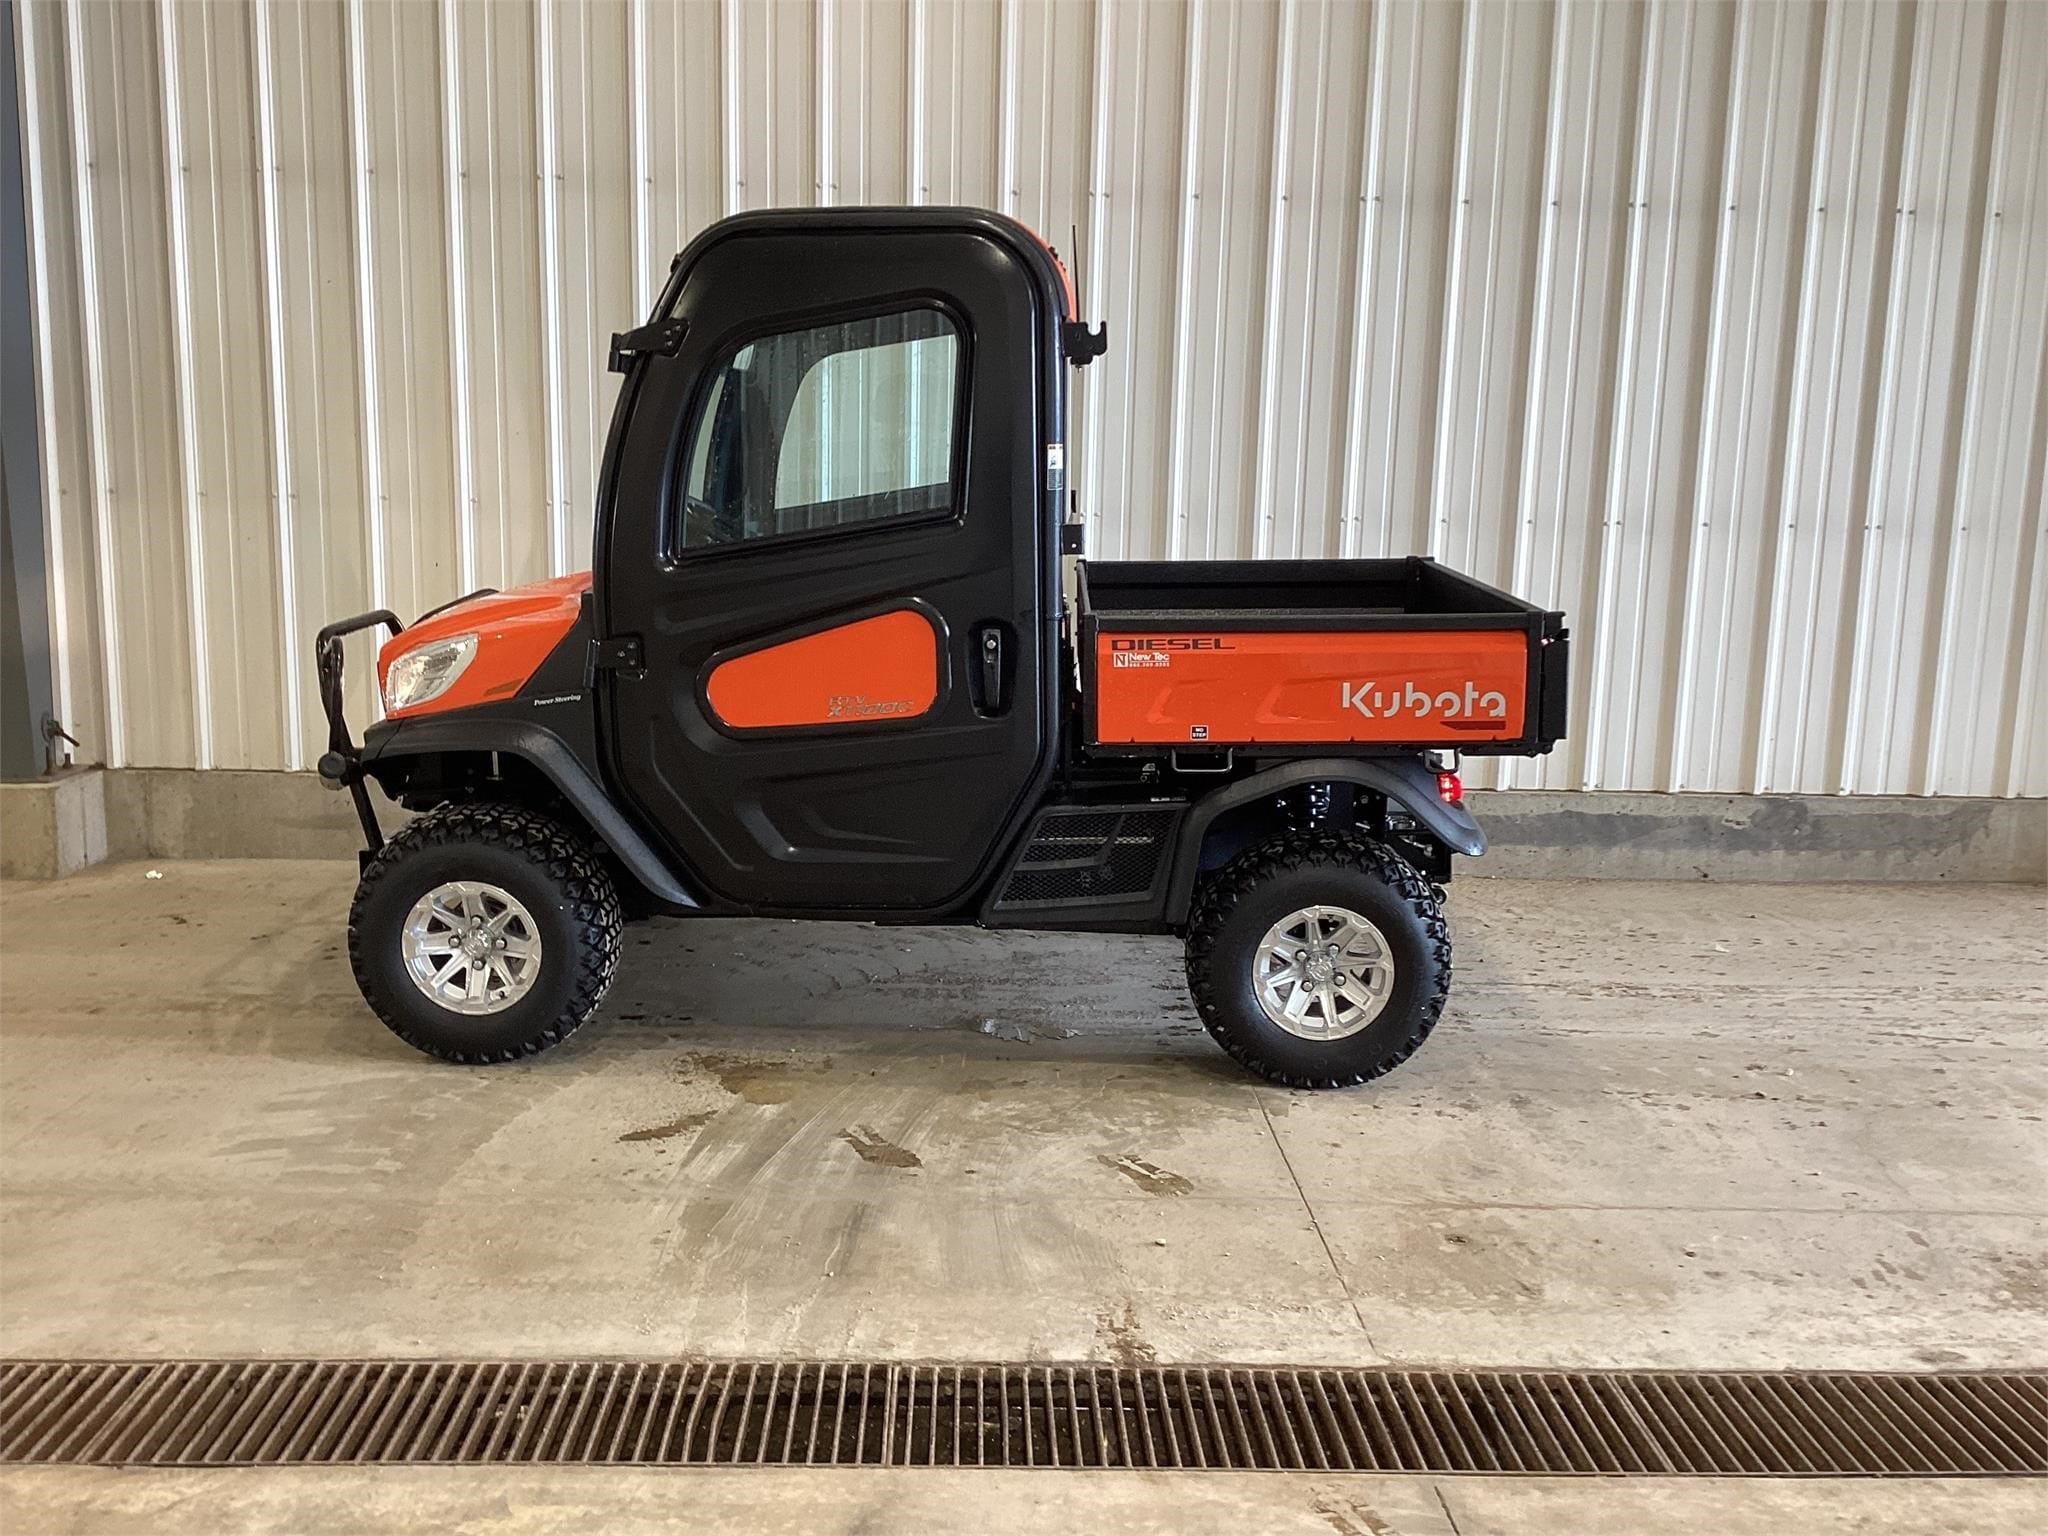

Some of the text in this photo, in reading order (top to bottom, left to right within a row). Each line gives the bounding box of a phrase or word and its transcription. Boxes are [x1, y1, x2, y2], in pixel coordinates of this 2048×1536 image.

[1111, 639, 1236, 651] DIESEL
[1129, 652, 1170, 661] New Tec
[534, 694, 581, 706] Power Steering
[1342, 681, 1506, 718] Kubota
